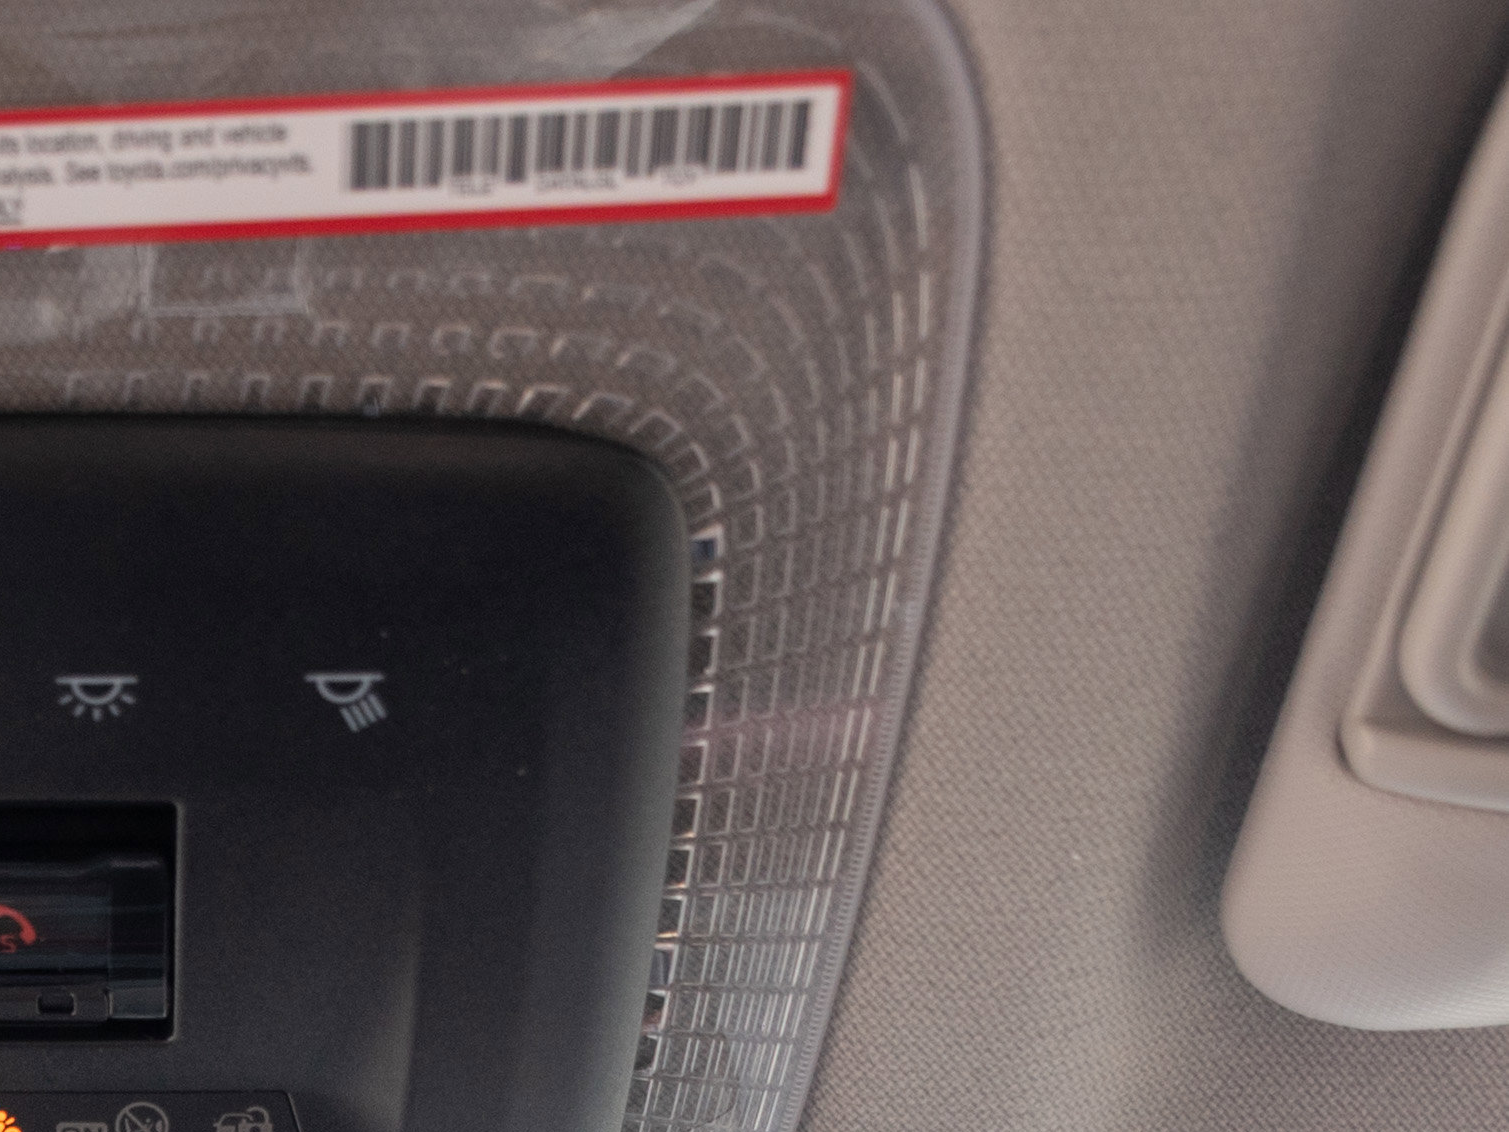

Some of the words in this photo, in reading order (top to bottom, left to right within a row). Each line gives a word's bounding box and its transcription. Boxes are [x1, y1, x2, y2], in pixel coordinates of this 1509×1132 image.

[110, 129, 172, 153] driving
[179, 126, 214, 147] and
[222, 123, 287, 145] vehicle
